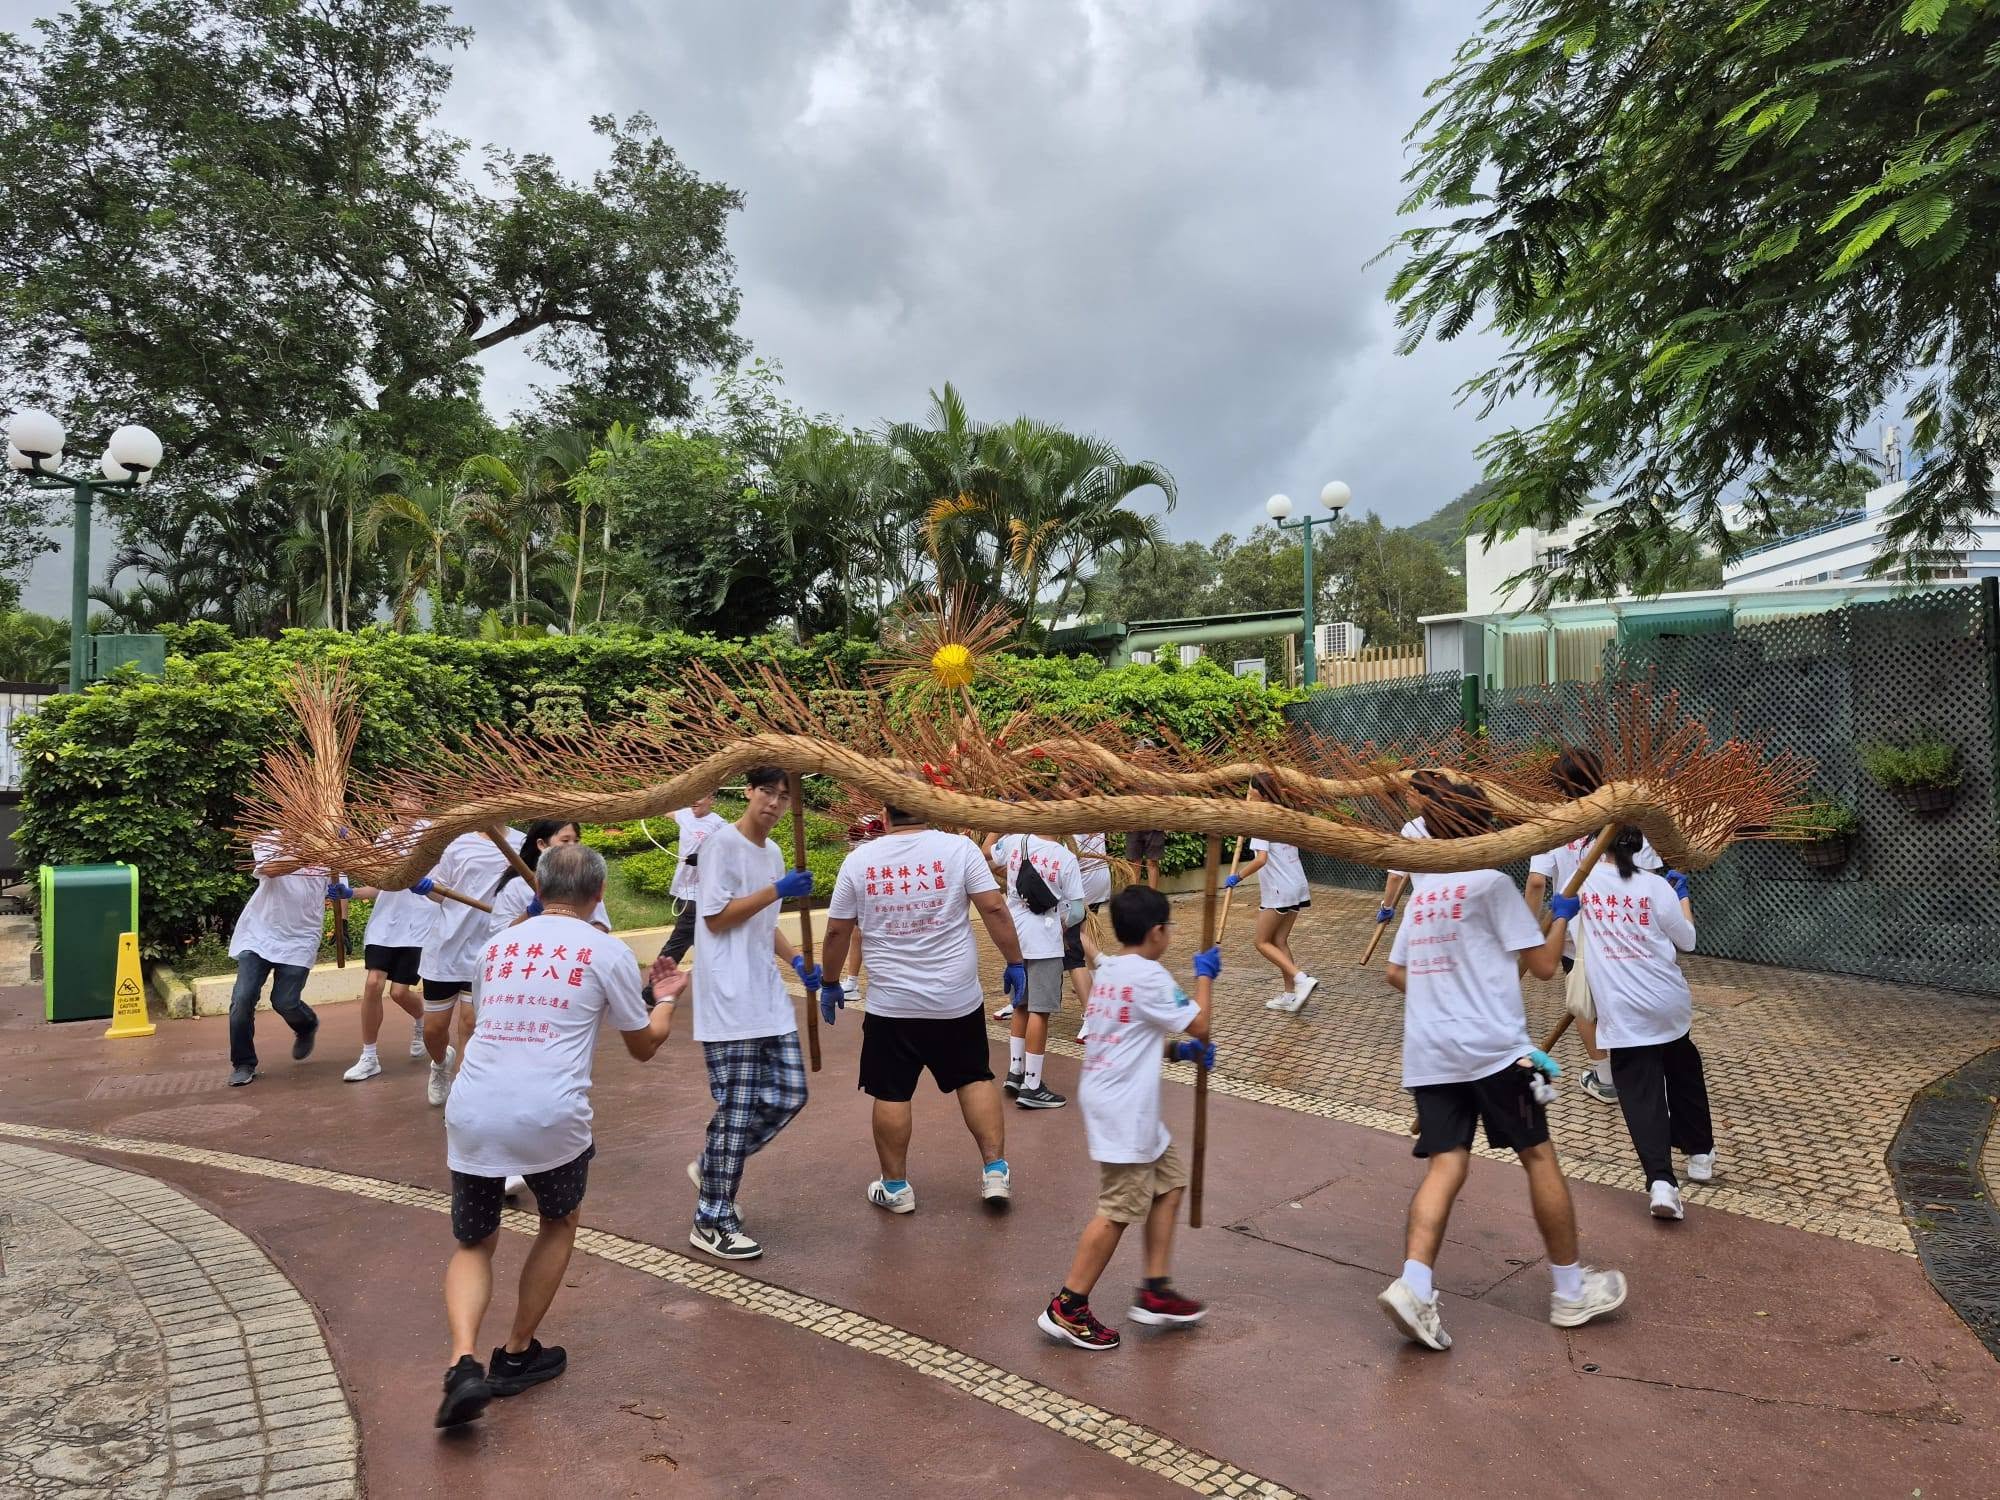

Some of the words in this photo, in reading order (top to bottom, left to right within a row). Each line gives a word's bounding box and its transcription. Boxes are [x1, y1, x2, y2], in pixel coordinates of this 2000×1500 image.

[866, 860, 945, 881] 薄扶林火龍
[1011, 849, 1060, 871] 薄林火龍
[866, 876, 946, 896] 龍游十八區
[486, 943, 593, 965] 薄扶林火龍
